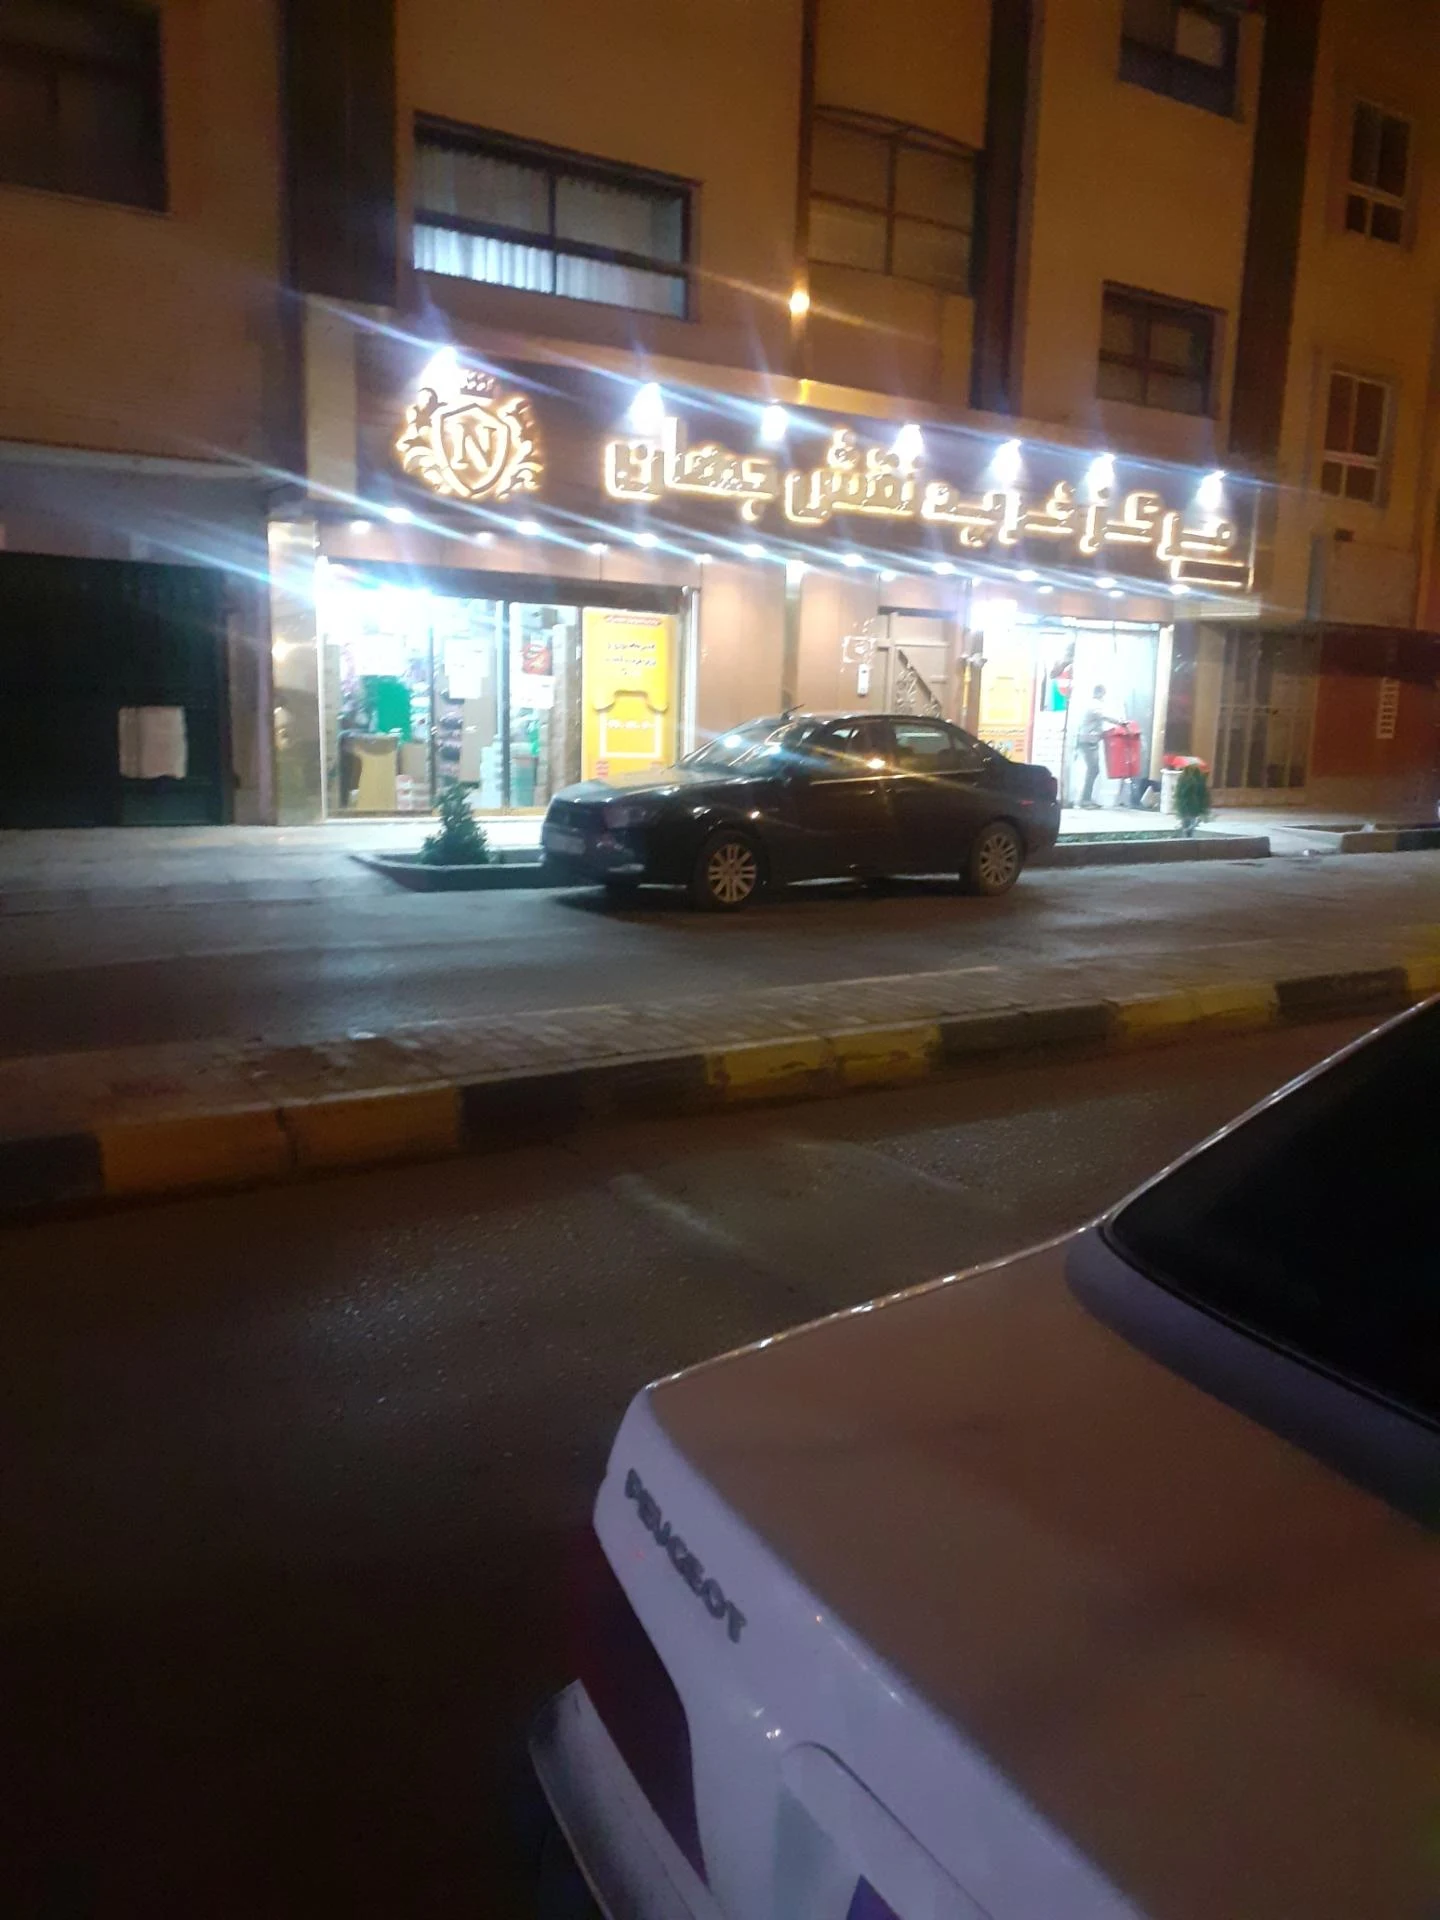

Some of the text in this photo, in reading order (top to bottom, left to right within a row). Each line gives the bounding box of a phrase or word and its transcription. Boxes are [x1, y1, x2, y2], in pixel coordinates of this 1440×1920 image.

[449, 421, 499, 473] N
[604, 416, 1237, 562] مرکز خرید نقش جهان
[624, 1467, 747, 1643] PEUGEOT
